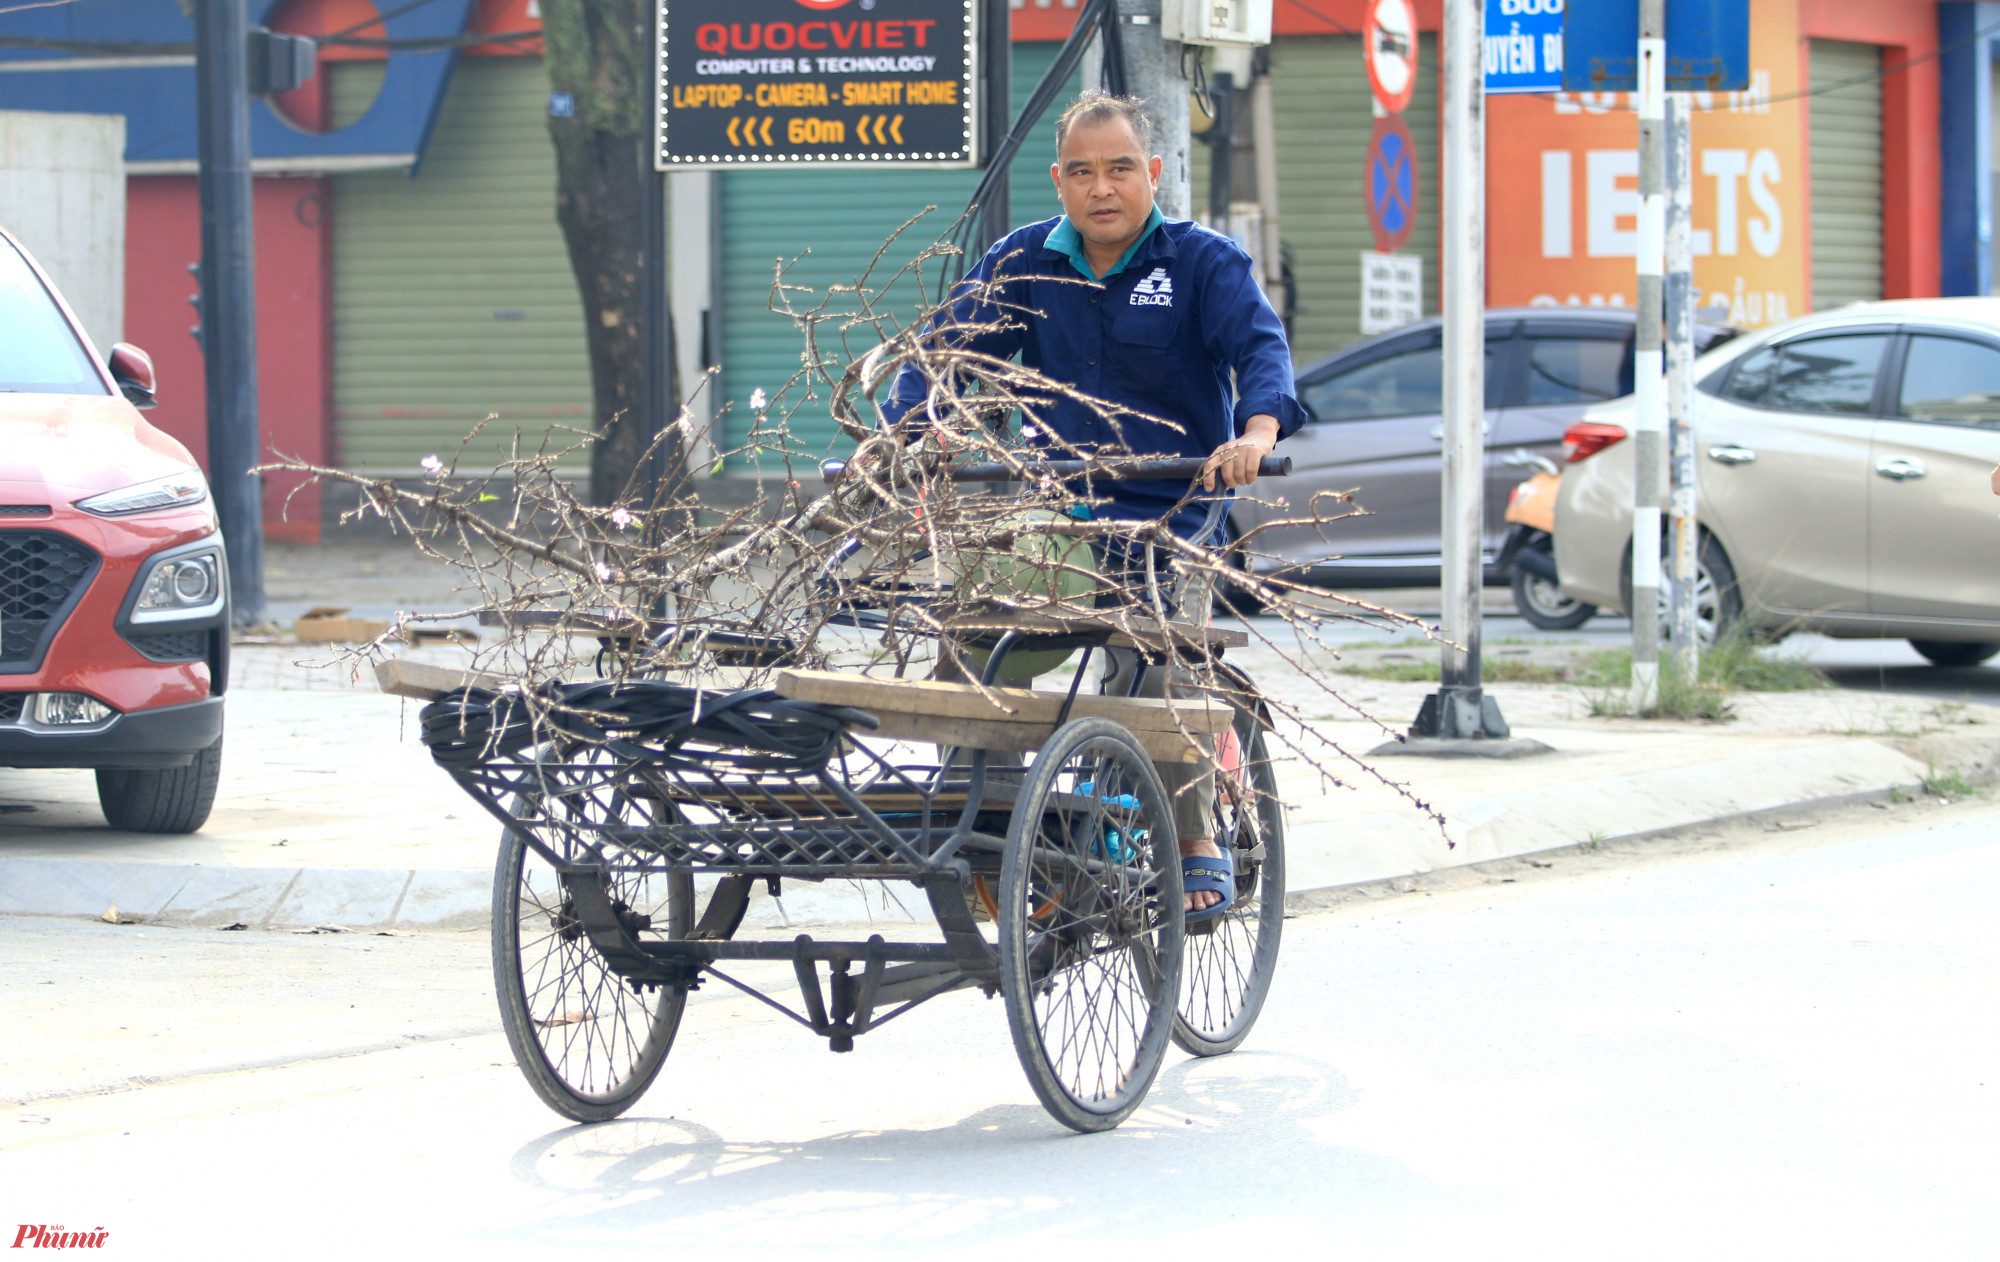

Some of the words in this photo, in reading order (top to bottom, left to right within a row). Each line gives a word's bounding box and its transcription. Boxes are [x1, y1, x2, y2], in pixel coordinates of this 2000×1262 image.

[696, 20, 936, 55] QUOCVIET
[696, 58, 794, 75] COMPUTER
[798, 57, 812, 73] &
[819, 56, 936, 73] TECHNOLOGY
[673, 84, 742, 108] LAPTOP
[756, 83, 828, 107] CAMERA
[842, 82, 903, 106] SMART
[906, 81, 957, 105] HOME
[788, 117, 844, 144] 60m
[1542, 149, 1782, 258] IETS
